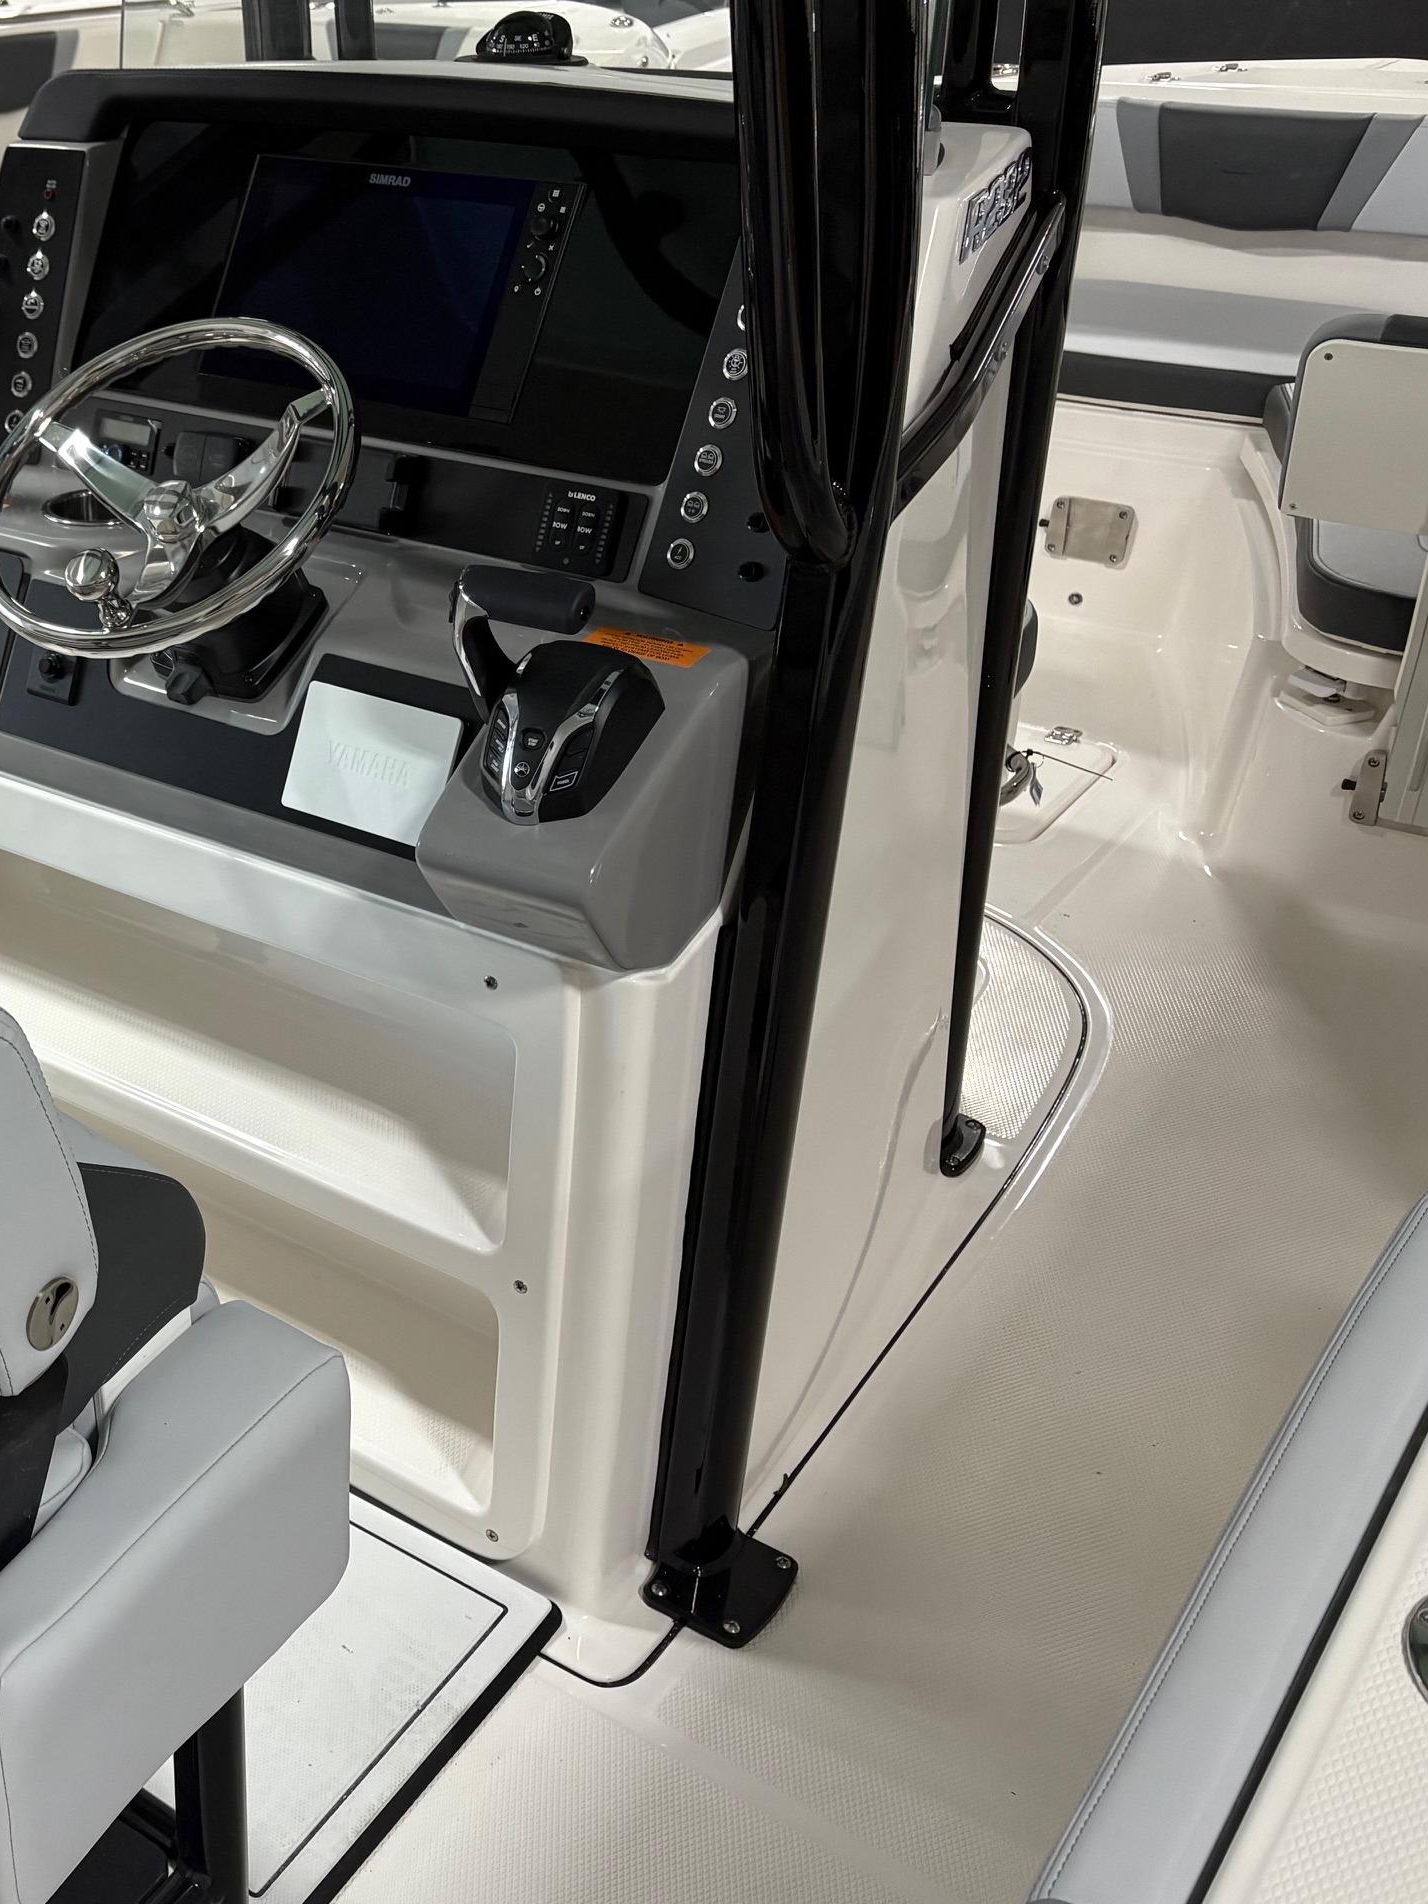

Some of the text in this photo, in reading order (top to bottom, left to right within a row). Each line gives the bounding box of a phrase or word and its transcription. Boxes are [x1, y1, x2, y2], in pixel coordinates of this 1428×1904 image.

[369, 173, 411, 187] SIMRAD
[573, 491, 596, 502] LENCO
[326, 738, 414, 789] YAMAHA
